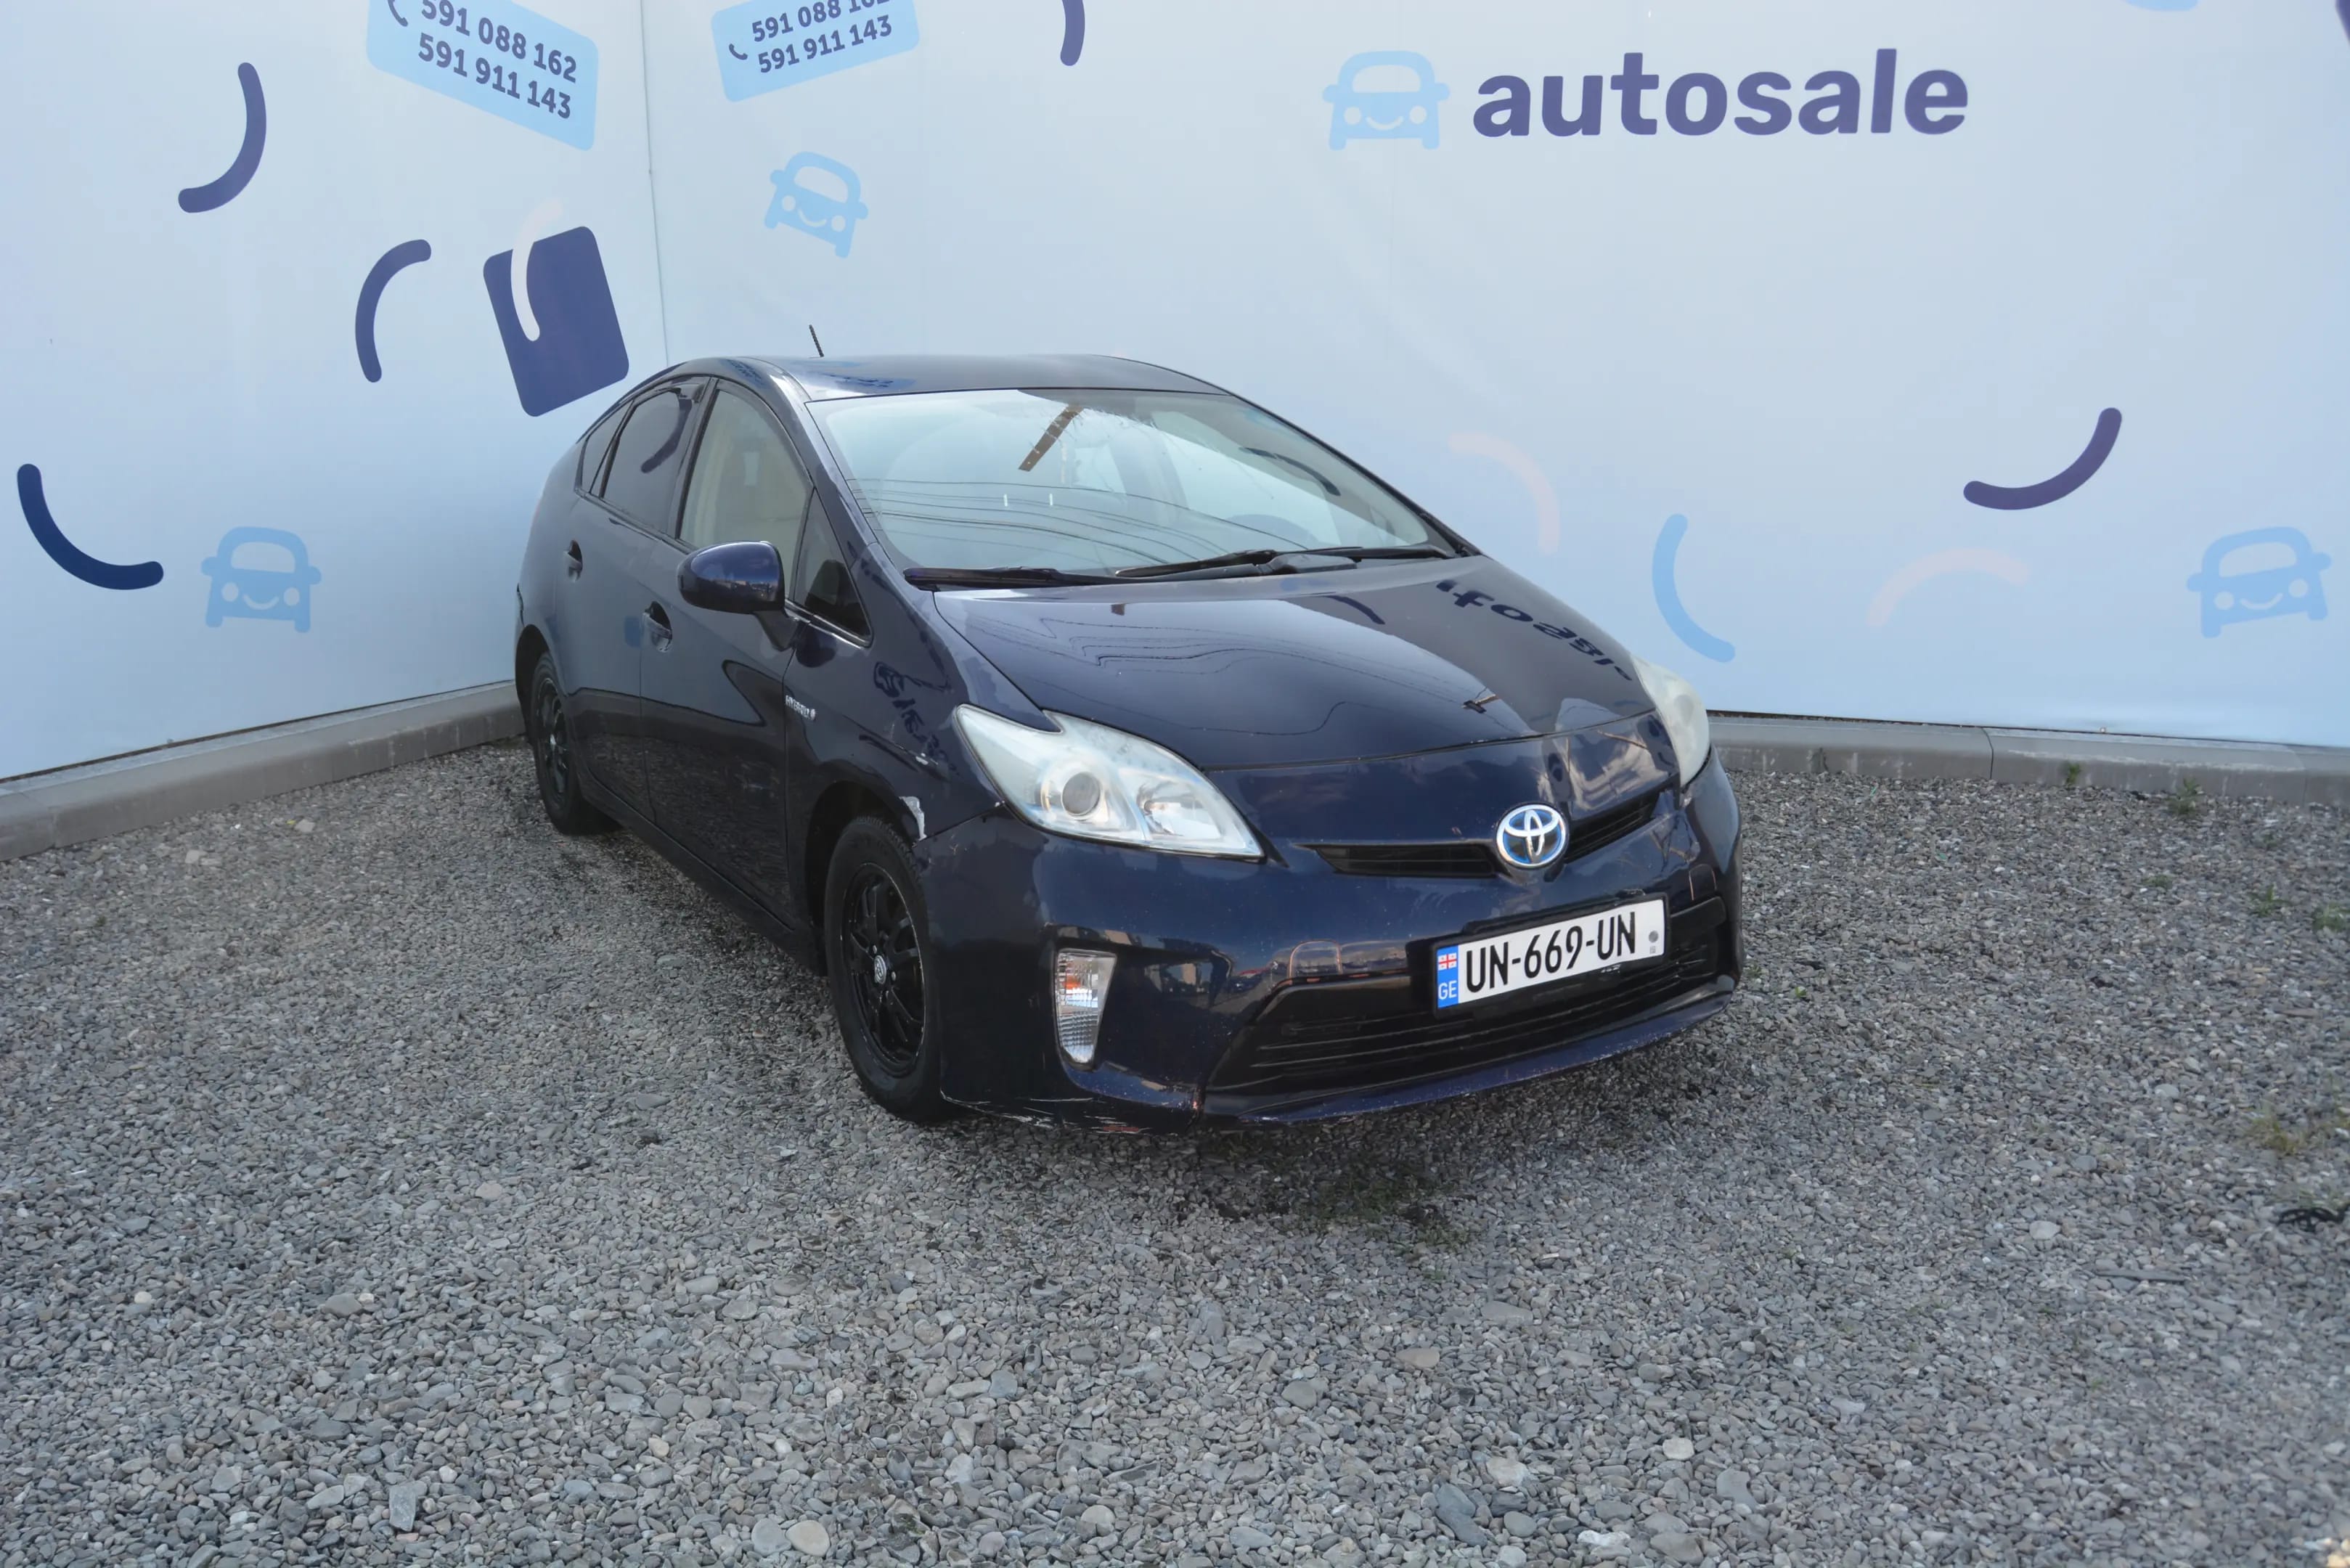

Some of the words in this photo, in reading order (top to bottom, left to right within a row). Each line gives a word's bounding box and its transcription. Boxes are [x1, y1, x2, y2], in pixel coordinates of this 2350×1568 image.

[421, 0, 470, 36] 591
[478, 17, 527, 60] 088
[534, 42, 577, 83] 162
[751, 12, 793, 42] 591
[798, 0, 841, 28] 088
[758, 44, 800, 73] 591
[803, 30, 846, 60] 911
[849, 14, 892, 46] 143
[418, 32, 468, 78] 591
[476, 57, 521, 99] 911
[527, 80, 571, 119] 143
[1472, 48, 1969, 138] autosale
[1438, 980, 1457, 1000] GE
[1466, 911, 1636, 993] UN-669-UN
